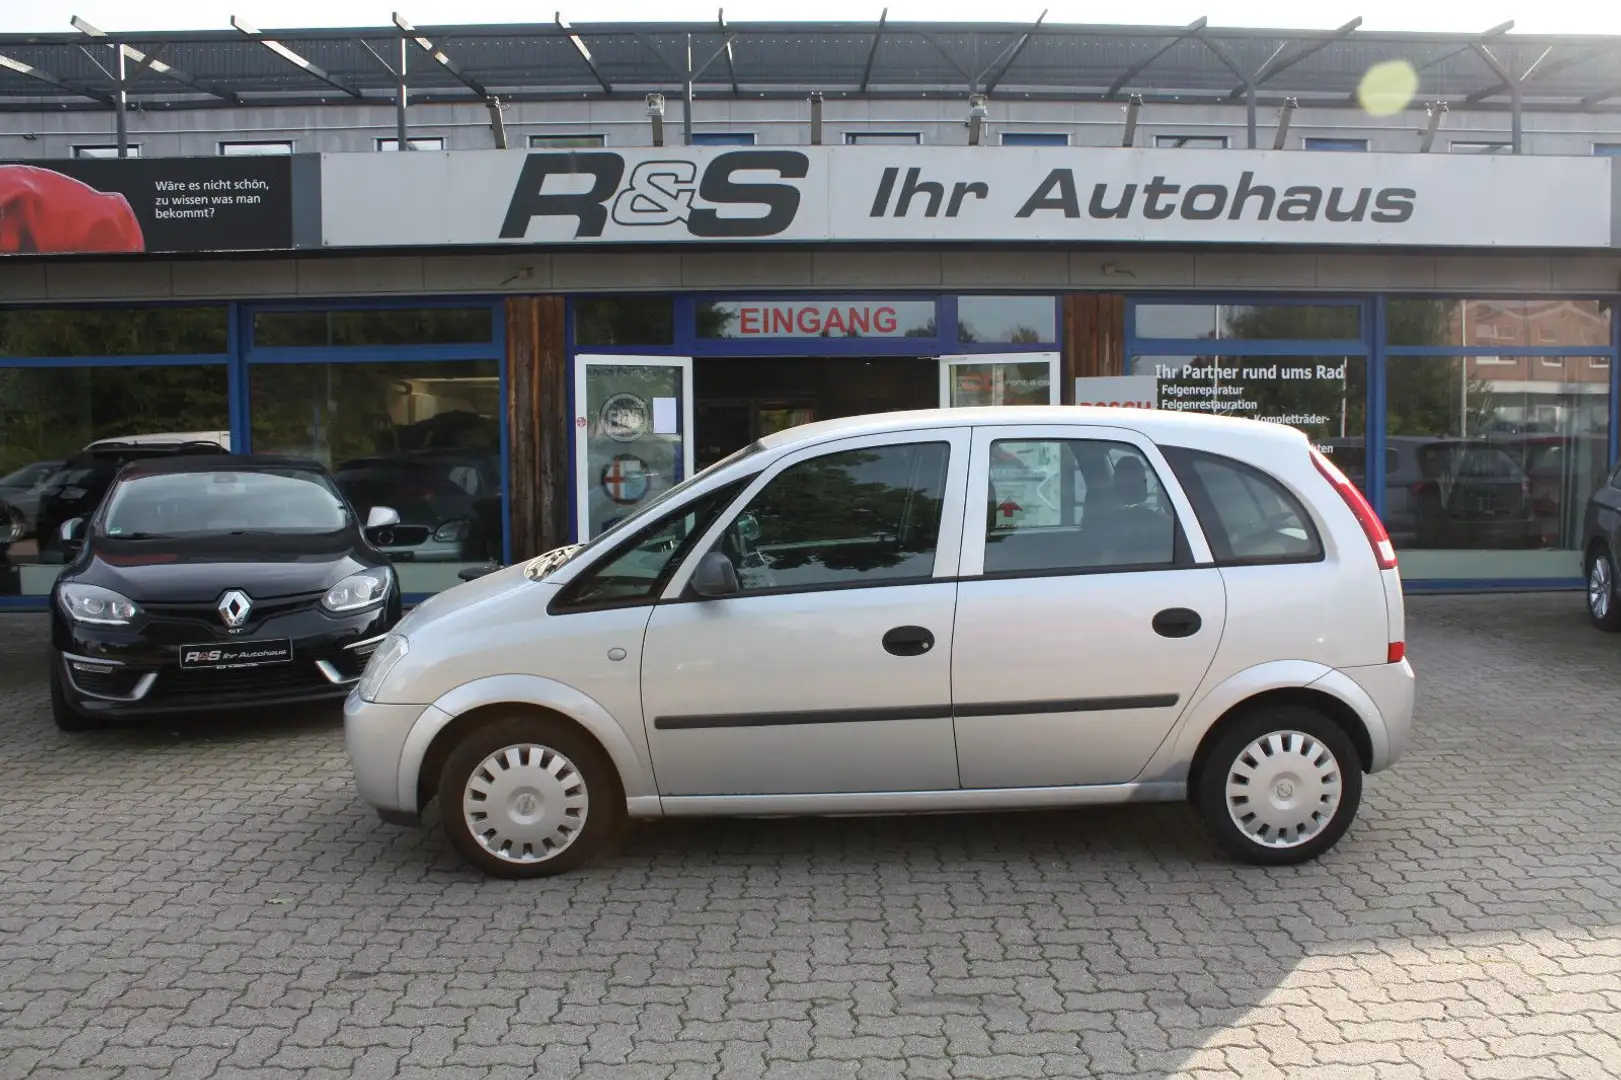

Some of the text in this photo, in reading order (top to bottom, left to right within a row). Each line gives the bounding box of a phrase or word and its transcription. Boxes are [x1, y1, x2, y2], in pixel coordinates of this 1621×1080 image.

[155, 178, 269, 191] Wäre es nicht schön,
[155, 194, 260, 206] zu wissen was man
[498, 150, 1416, 239] R&S Ihr Autohaus
[155, 207, 215, 218] bekommt?
[740, 307, 897, 334] EINGANG
[1155, 364, 1344, 380] Ihr Partner rund ums Rad
[1162, 384, 1244, 397] Felgenreparatur
[1162, 400, 1258, 410] Felgenrestauration
[238, 650, 287, 658] Autohaus
